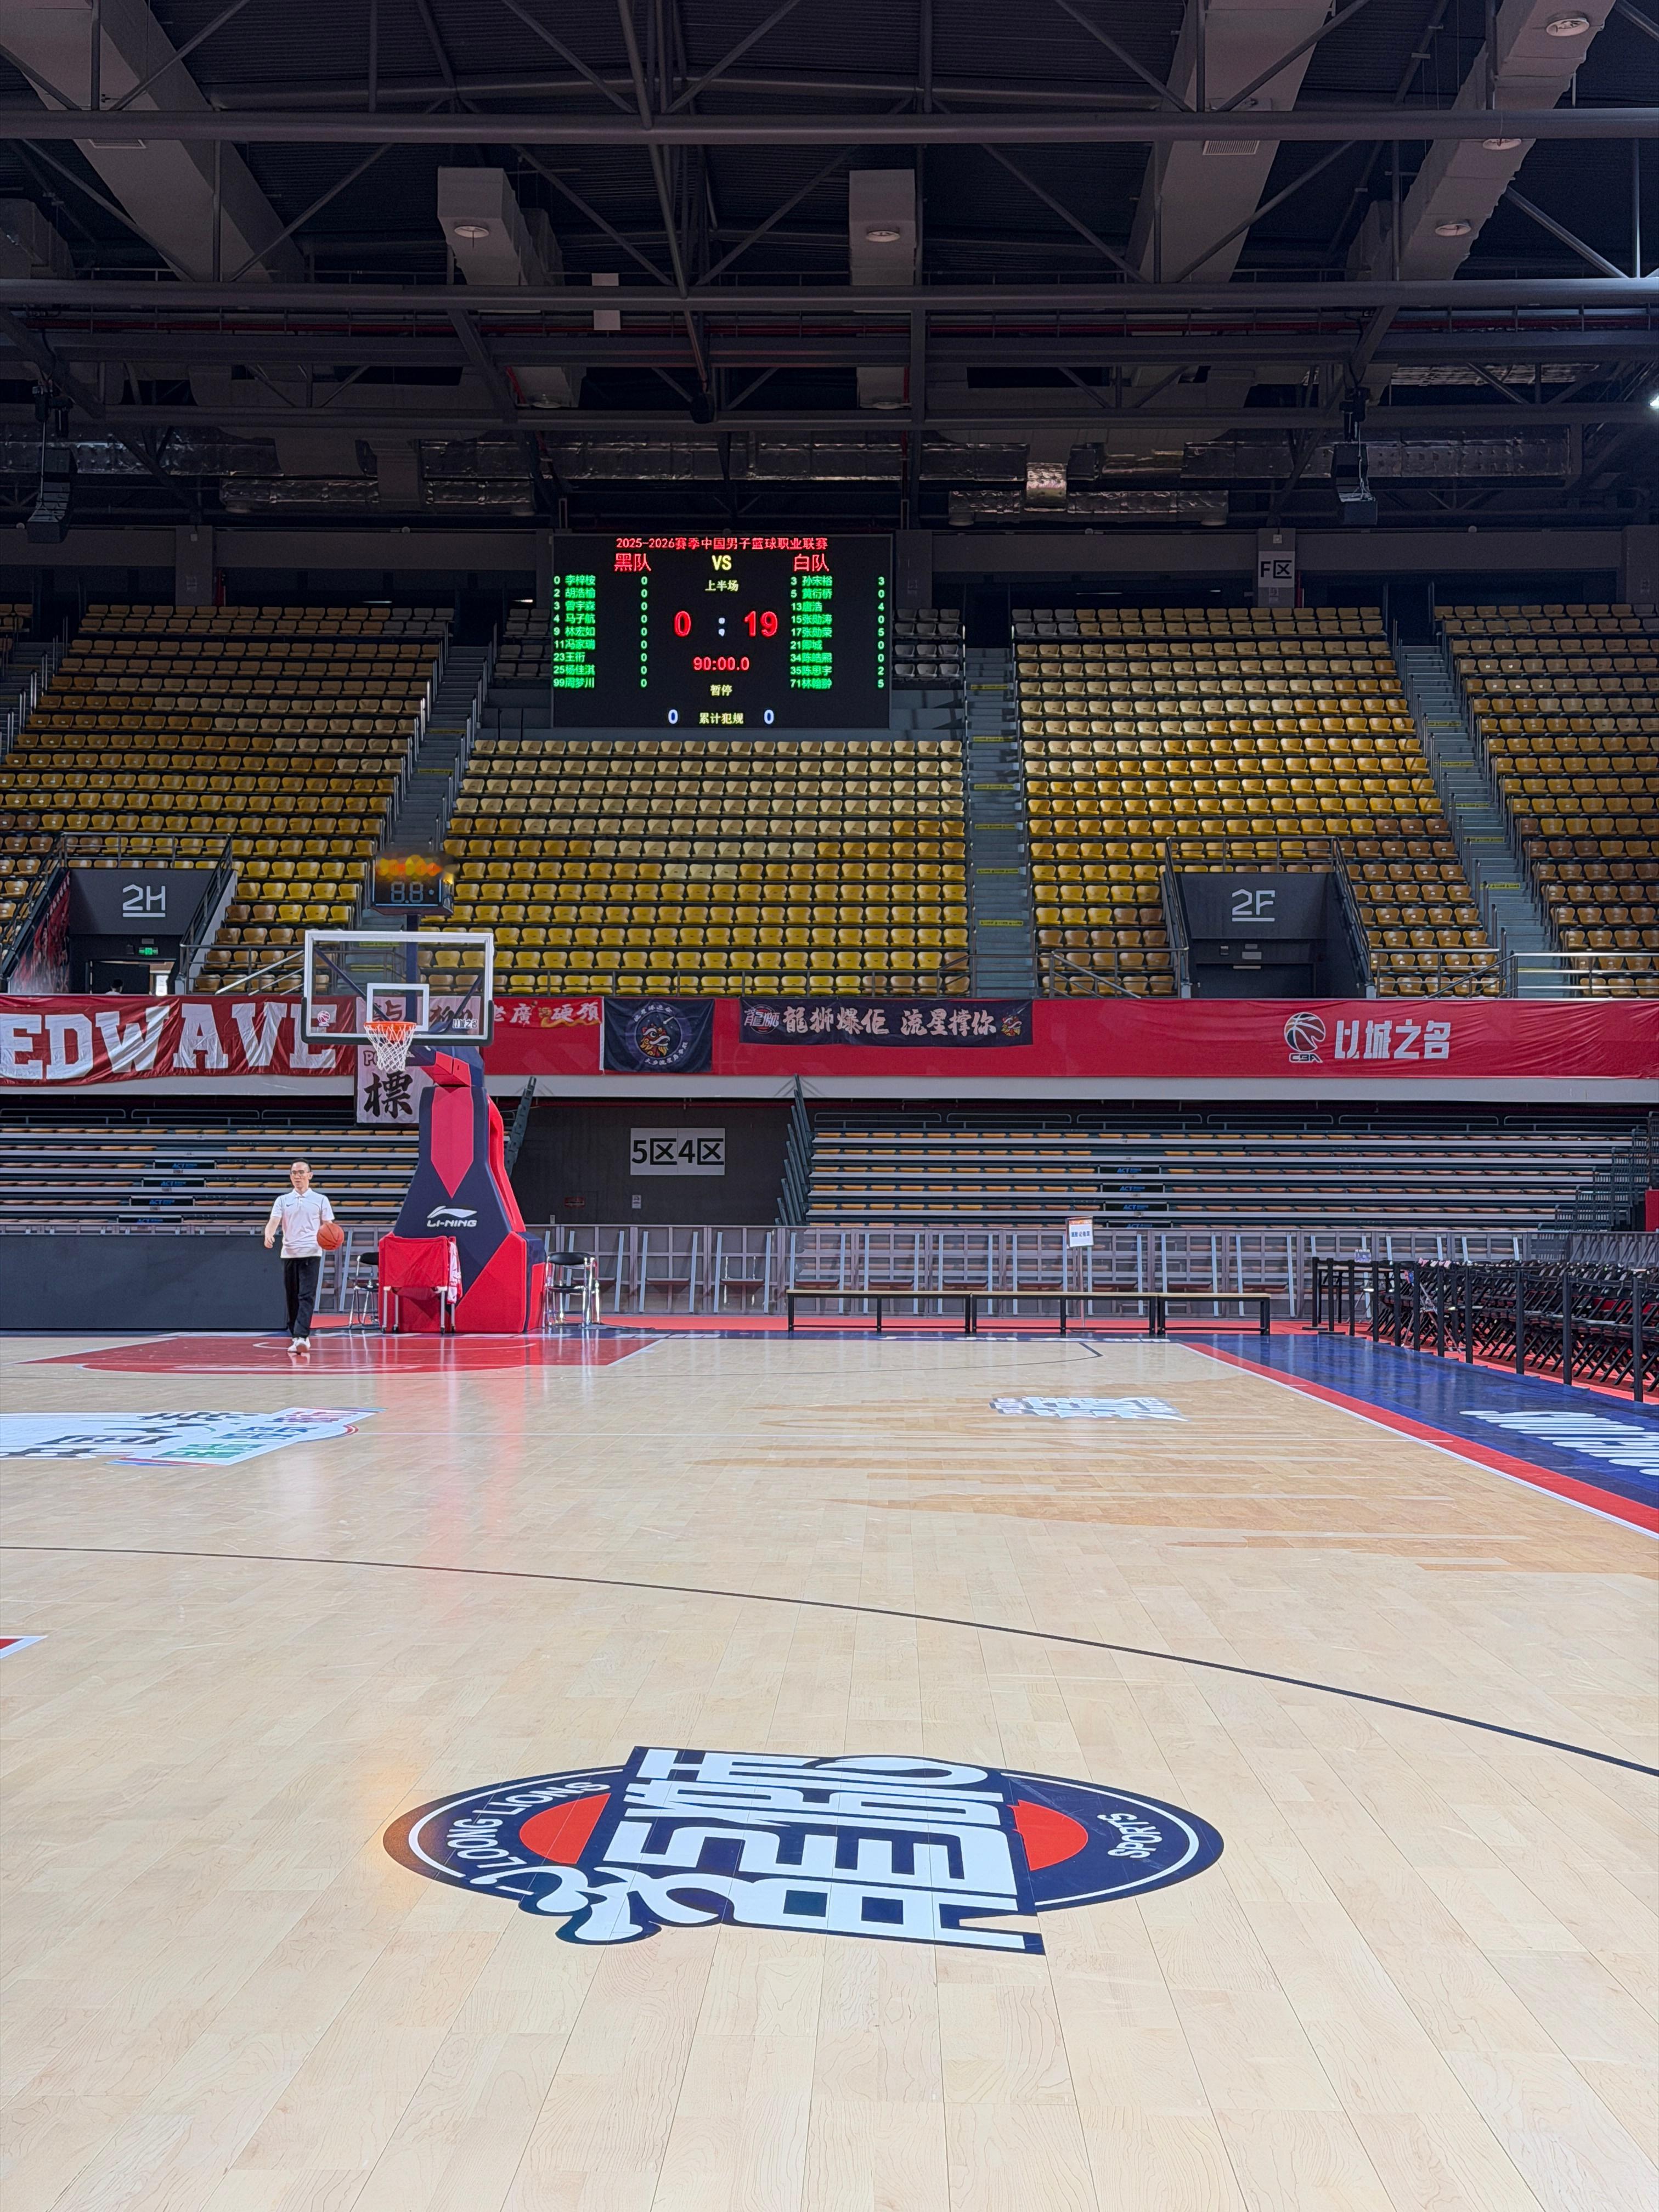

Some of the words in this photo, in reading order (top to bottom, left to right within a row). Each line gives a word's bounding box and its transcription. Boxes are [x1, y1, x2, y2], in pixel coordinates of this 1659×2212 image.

[614, 553, 651, 572] 黑队
[712, 555, 731, 570] VS
[794, 554, 829, 572] 白队
[1261, 560, 1292, 578] F区
[554, 576, 560, 584] 0
[706, 580, 738, 591] 上半场
[791, 577, 797, 585] 3
[554, 589, 560, 597] 2
[641, 589, 647, 597] 0
[791, 590, 797, 598] 5
[878, 590, 884, 598] 0
[554, 601, 560, 610] 3
[565, 613, 595, 624] 马子航
[674, 611, 691, 636] 0
[744, 611, 778, 637] 19
[554, 627, 560, 635] 9
[641, 628, 647, 636] 0
[878, 628, 884, 636] 5
[641, 640, 647, 648] 0
[878, 641, 884, 649] 0
[641, 653, 647, 662] 0
[693, 657, 749, 670] 90:00.0
[641, 666, 647, 674] 0
[878, 667, 884, 675] 2
[878, 679, 884, 687] 5
[710, 685, 732, 696] 暂停
[668, 709, 678, 724] 0
[699, 713, 743, 724] 累计犯规
[764, 709, 774, 724] 0
[122, 884, 166, 911] 2H
[1232, 889, 1276, 916] 2F
[452, 1019, 478, 1029] 以城之名
[1334, 1019, 1451, 1059] 以城之名
[1289, 1052, 1323, 1063] CBA
[363, 1070, 413, 1120] 標
[631, 1138, 725, 1165] 5区4区
[427, 1219, 478, 1228] LI-NING
[472, 1782, 610, 1815] LIONS
[1097, 1813, 1163, 1859] SPORTS
[447, 1818, 527, 1868] LOONG
